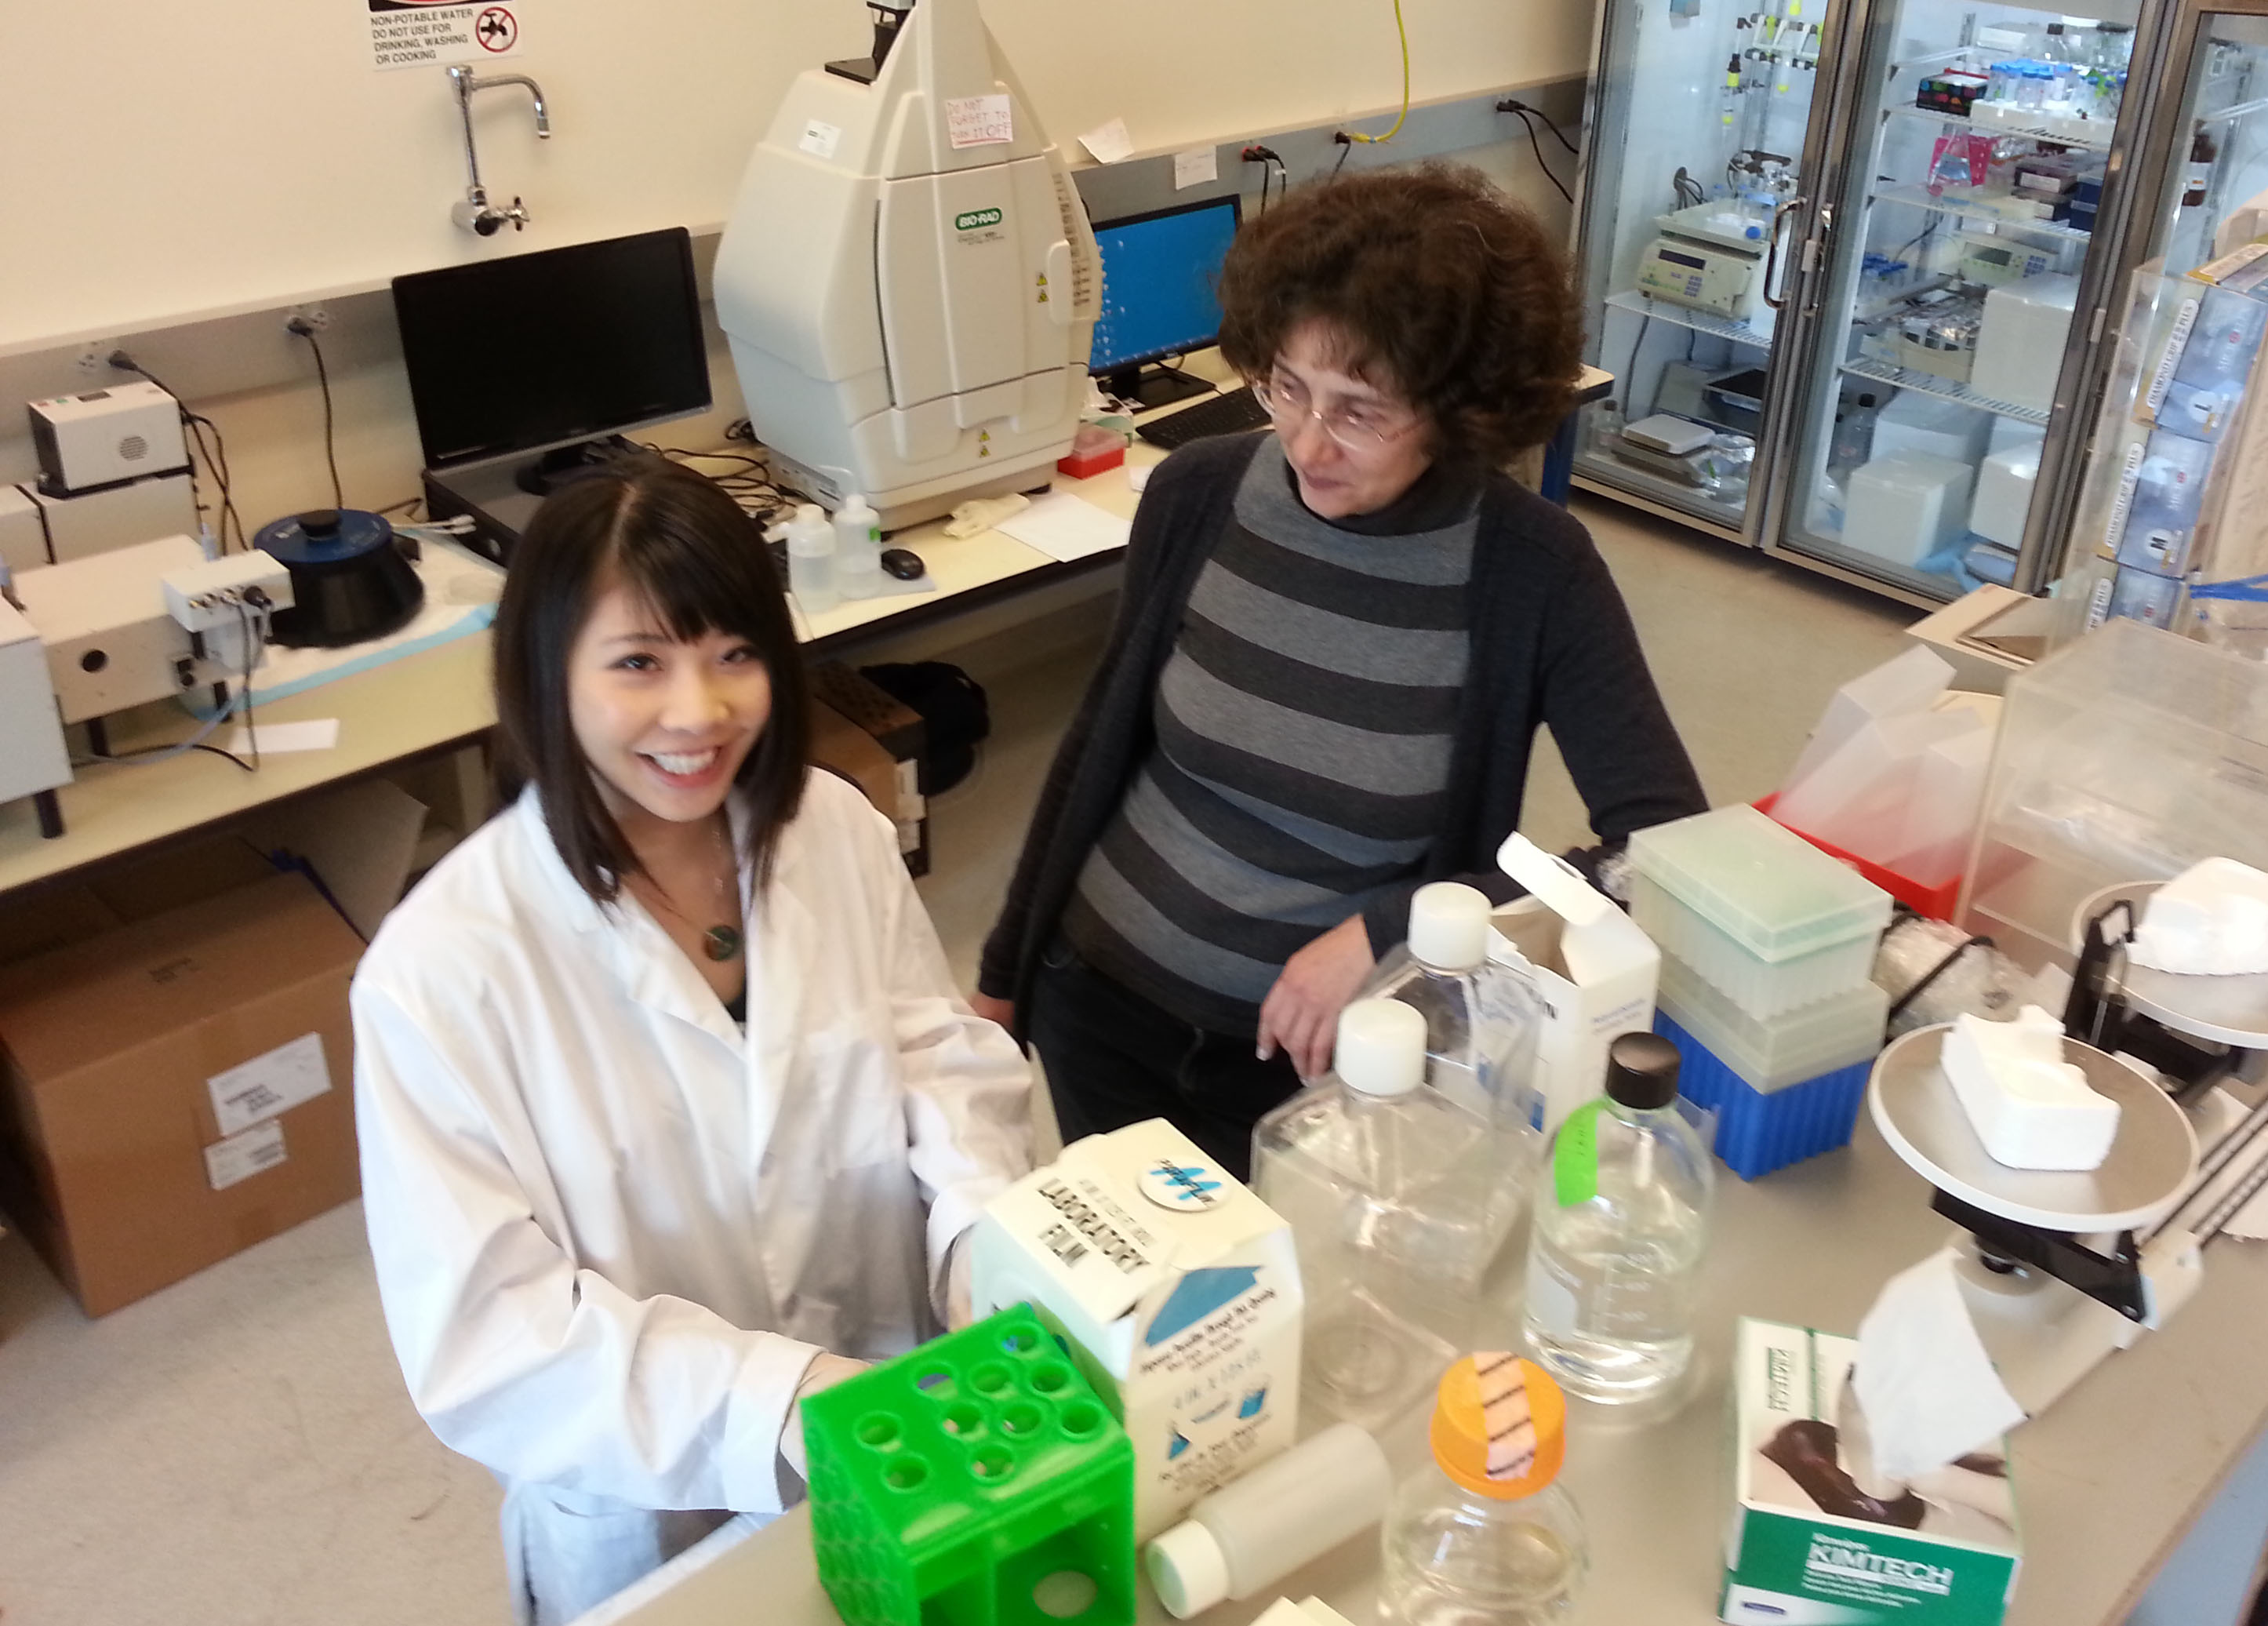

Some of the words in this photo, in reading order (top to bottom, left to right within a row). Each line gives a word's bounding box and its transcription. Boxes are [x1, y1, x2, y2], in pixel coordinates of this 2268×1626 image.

[371, 11, 438, 26] NON-POTABLE
[441, 9, 474, 20] WATER
[373, 29, 387, 39] DO
[389, 27, 408, 37] NOT
[411, 24, 430, 35] USE
[433, 23, 451, 33] FOR
[425, 34, 469, 45] WASHING
[376, 54, 391, 64] OR
[392, 49, 437, 63] COOKING
[986, 122, 1012, 137] OFF
[958, 210, 1001, 227] BIO-RAD
[2150, 536, 2168, 551] M
[1037, 1177, 1150, 1275] LABORATORY
[1038, 1221, 1090, 1268] FILM
[1808, 1542, 1955, 1587] KIMTECH
